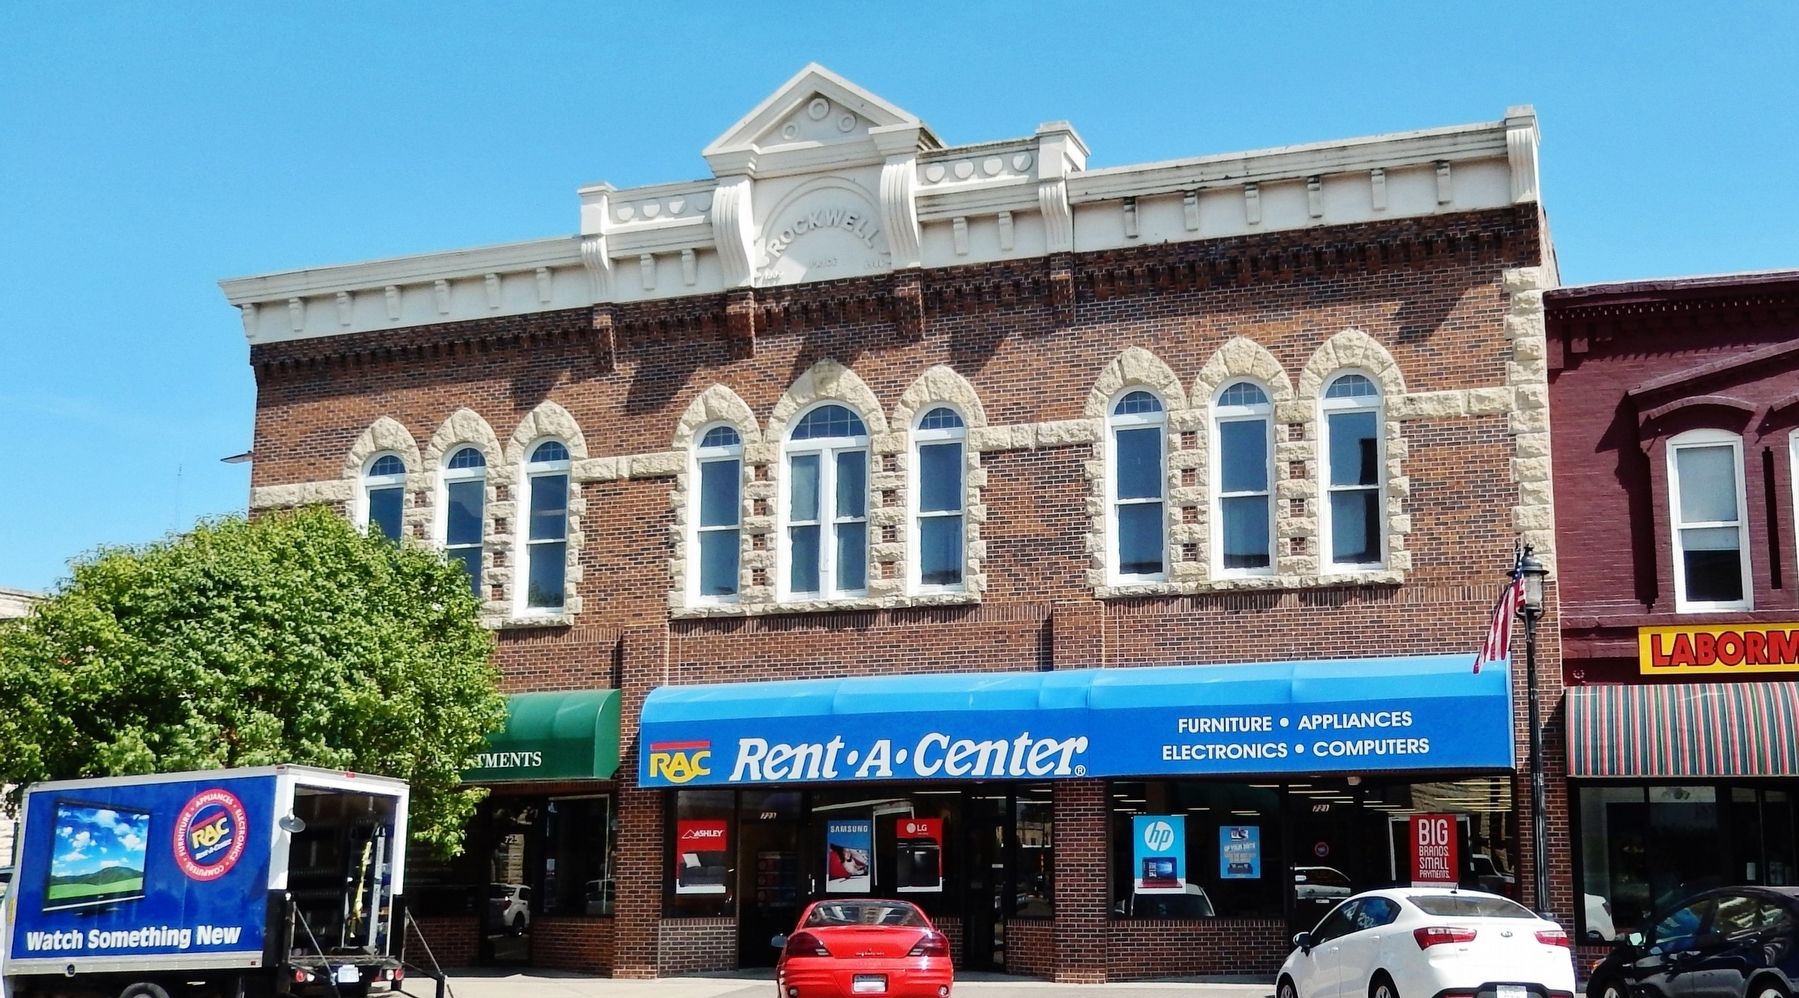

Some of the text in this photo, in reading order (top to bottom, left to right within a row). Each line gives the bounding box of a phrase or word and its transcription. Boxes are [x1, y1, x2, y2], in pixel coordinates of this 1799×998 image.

[767, 208, 880, 257] ROCKWELL
[1651, 630, 1799, 667] LABORM
[1178, 711, 1412, 733] FURNITURE APPLIANCES
[1162, 738, 1430, 761] ELECTRONICS COMPUTERS
[649, 750, 711, 784] RAC
[195, 793, 234, 808] APPLIANCES
[177, 812, 192, 857] FURNITURE
[191, 817, 230, 849] RAC
[229, 808, 246, 861] ELECTRONICS
[694, 829, 723, 837] ASHLEY
[830, 825, 868, 833] SAMSUNG
[917, 824, 928, 832] LG
[1148, 821, 1171, 852] hp
[1418, 818, 1448, 846] BIG
[186, 861, 225, 877] COMPUTERS
[1419, 857, 1449, 870] SMALL
[27, 925, 242, 951] Watch Something New
